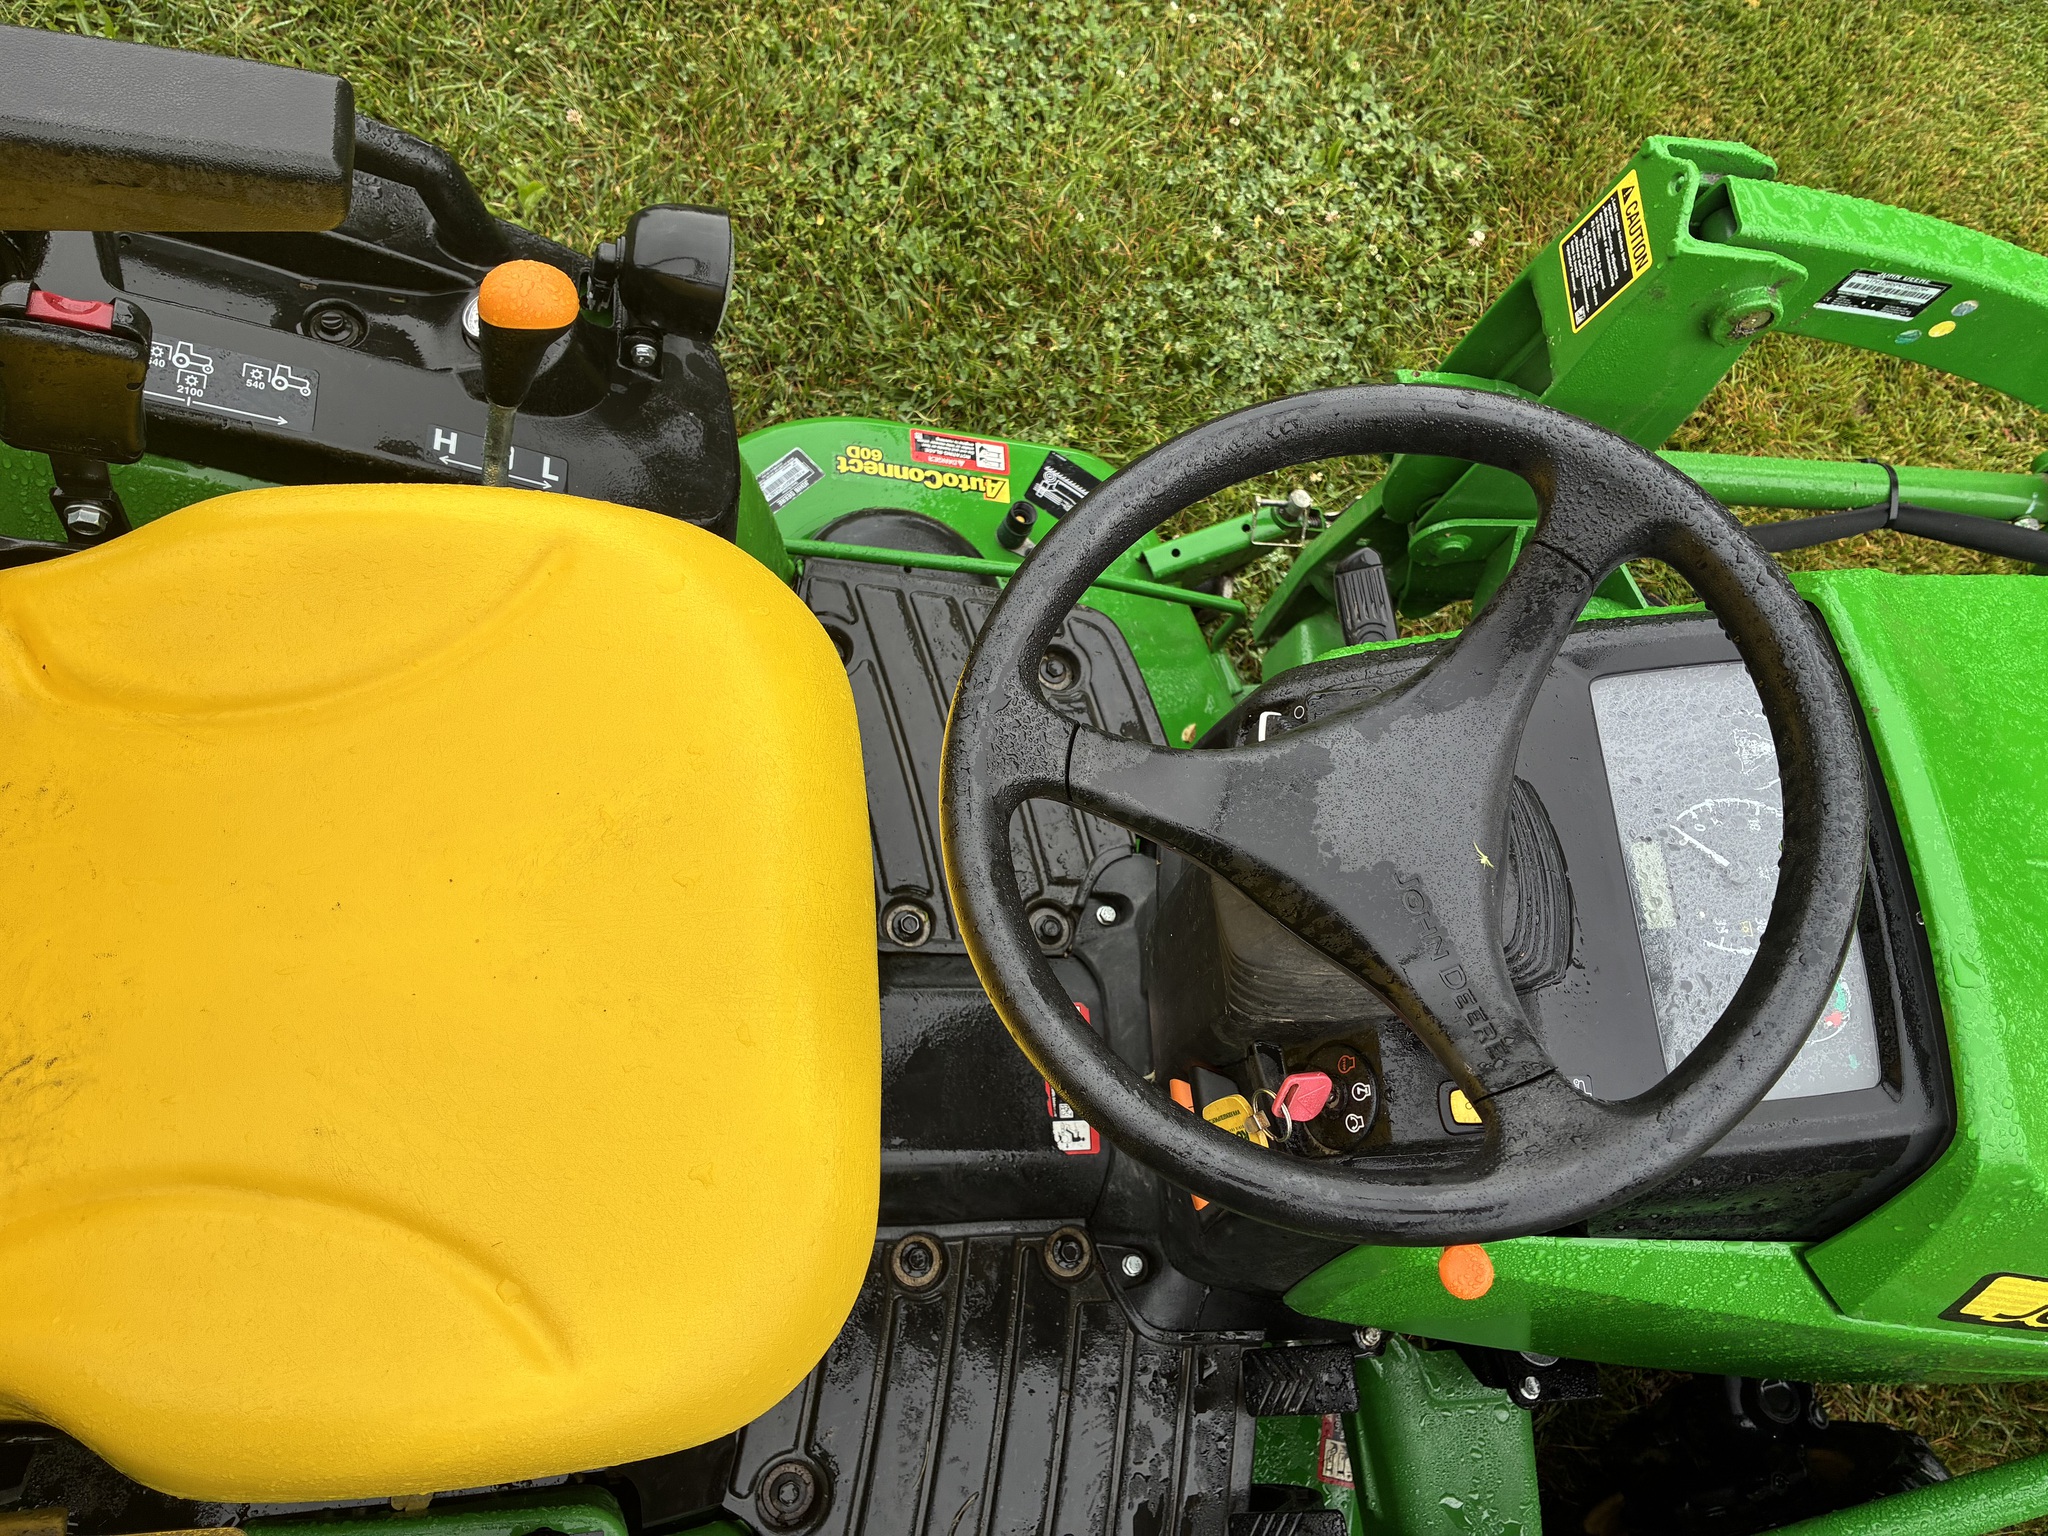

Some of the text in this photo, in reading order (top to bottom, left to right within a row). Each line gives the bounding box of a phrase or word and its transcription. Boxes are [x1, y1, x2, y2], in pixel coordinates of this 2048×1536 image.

[1626, 200, 1649, 272] CAUTION
[177, 384, 204, 398] 2100
[246, 379, 266, 390] 540
[433, 428, 458, 455] H
[846, 444, 884, 463] 60D
[541, 456, 559, 481] L
[927, 455, 957, 465] DANGER
[836, 454, 1007, 500] AutoConnect
[1394, 872, 1511, 1061] JOHN DEERE
